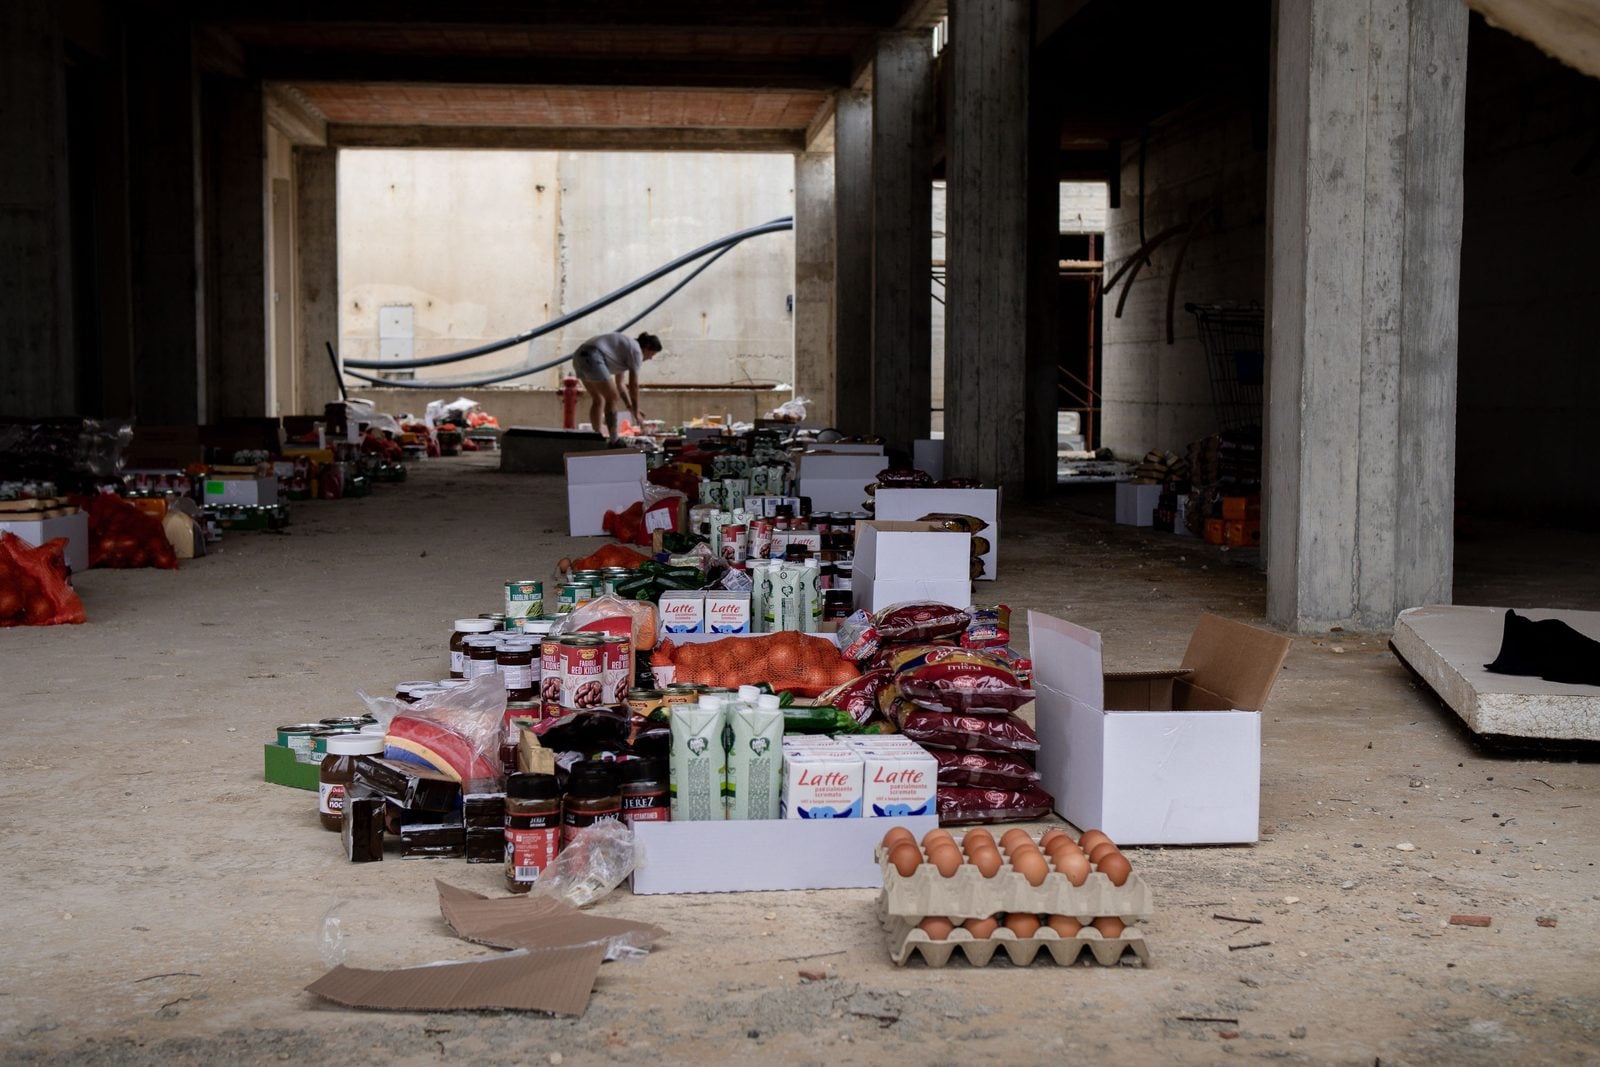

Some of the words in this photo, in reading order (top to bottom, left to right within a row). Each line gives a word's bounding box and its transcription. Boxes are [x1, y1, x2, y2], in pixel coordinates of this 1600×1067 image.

[665, 603, 694, 614] Latte
[711, 603, 740, 614] Latte
[571, 666, 582, 674] RED
[798, 769, 849, 786] Latte
[873, 766, 924, 783] Latte
[624, 796, 654, 809] JEREZ
